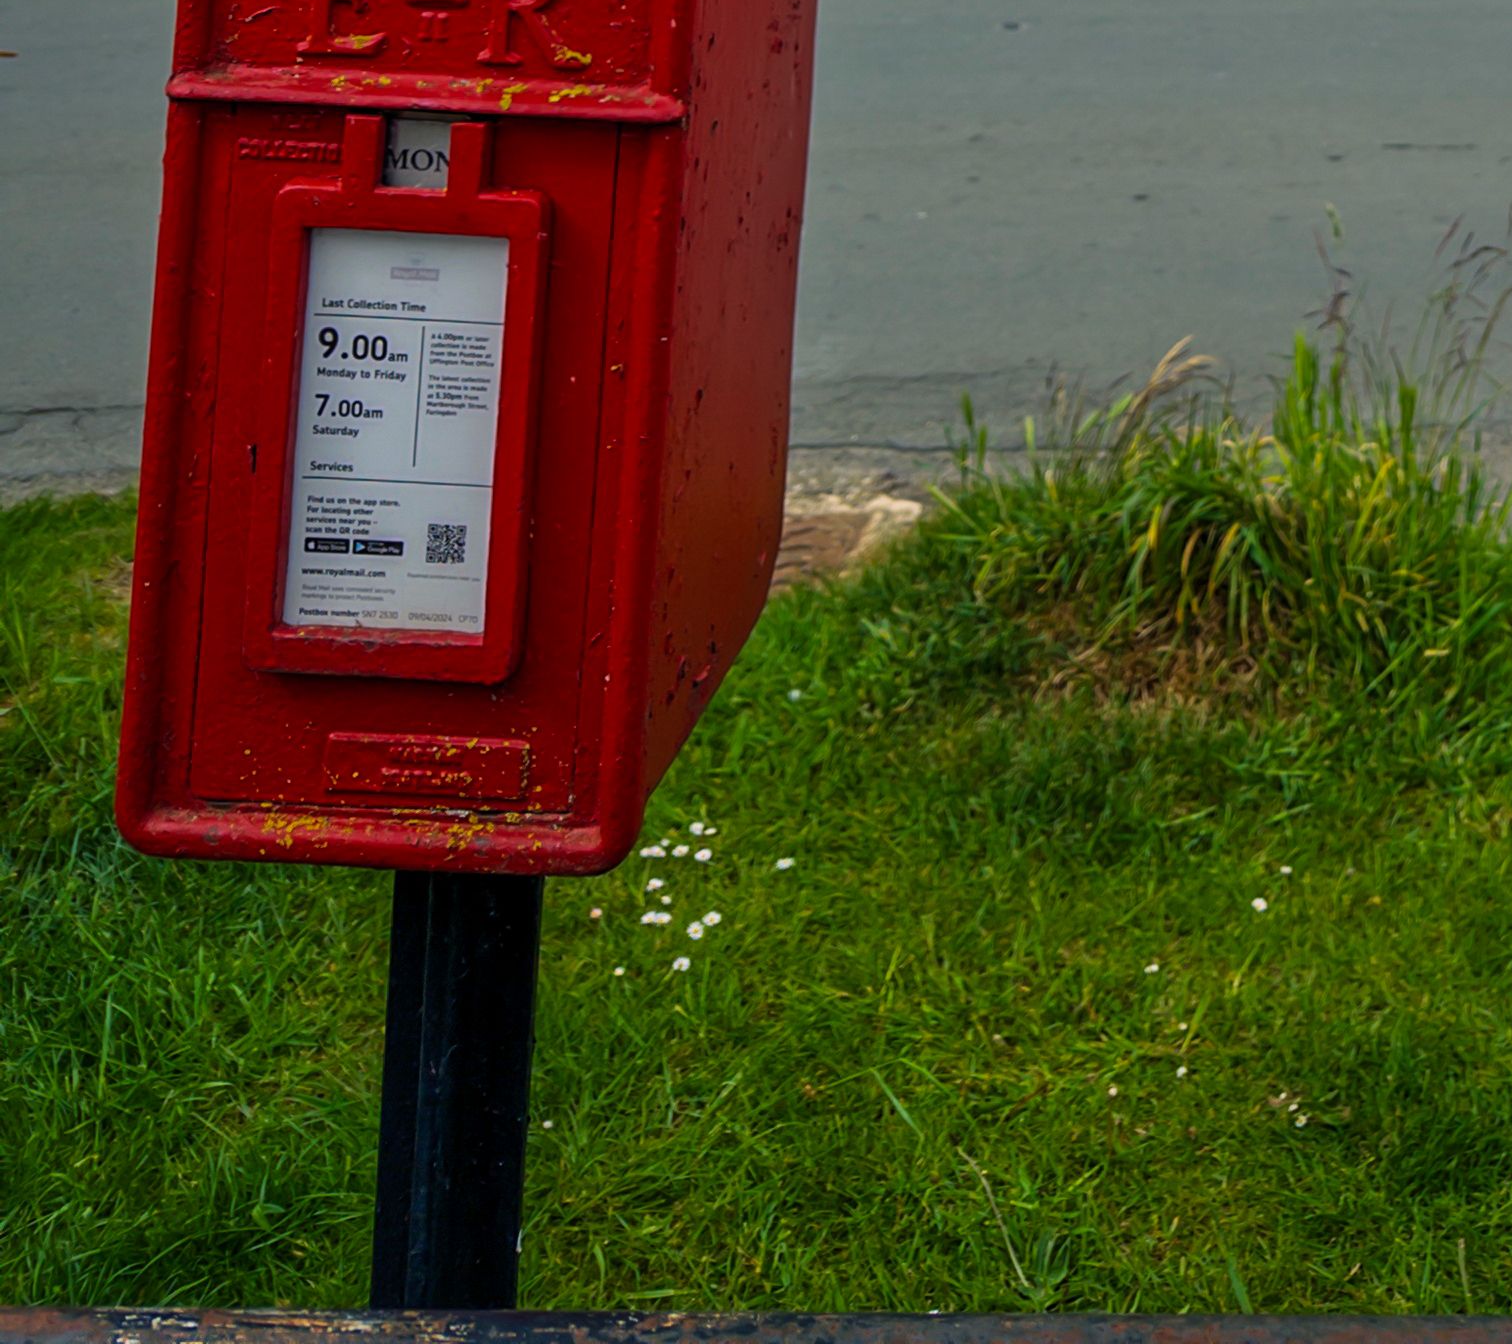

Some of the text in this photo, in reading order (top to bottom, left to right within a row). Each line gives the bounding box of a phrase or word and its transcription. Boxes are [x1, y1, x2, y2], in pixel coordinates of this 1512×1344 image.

[237, 137, 344, 162] COLLECTIO
[384, 148, 450, 172] MON
[322, 298, 426, 312] Last Collection Time
[437, 333, 464, 341] 4.00pm
[318, 326, 408, 362] 9.00am
[317, 367, 406, 382] Monday to Friday
[435, 392, 462, 400] 5.30pm
[315, 393, 383, 418] 7.00am
[313, 425, 359, 437] Saturday
[310, 460, 354, 472] Services
[307, 495, 324, 503] Find
[307, 505, 319, 513] For
[321, 506, 351, 516] locating
[306, 516, 337, 524] services
[339, 526, 350, 534] QR
[367, 545, 388, 553] Google
[301, 568, 386, 577] www.royalmail.com
[299, 608, 328, 616] Postbox
[330, 609, 359, 617] number
[362, 610, 376, 618] SN7
